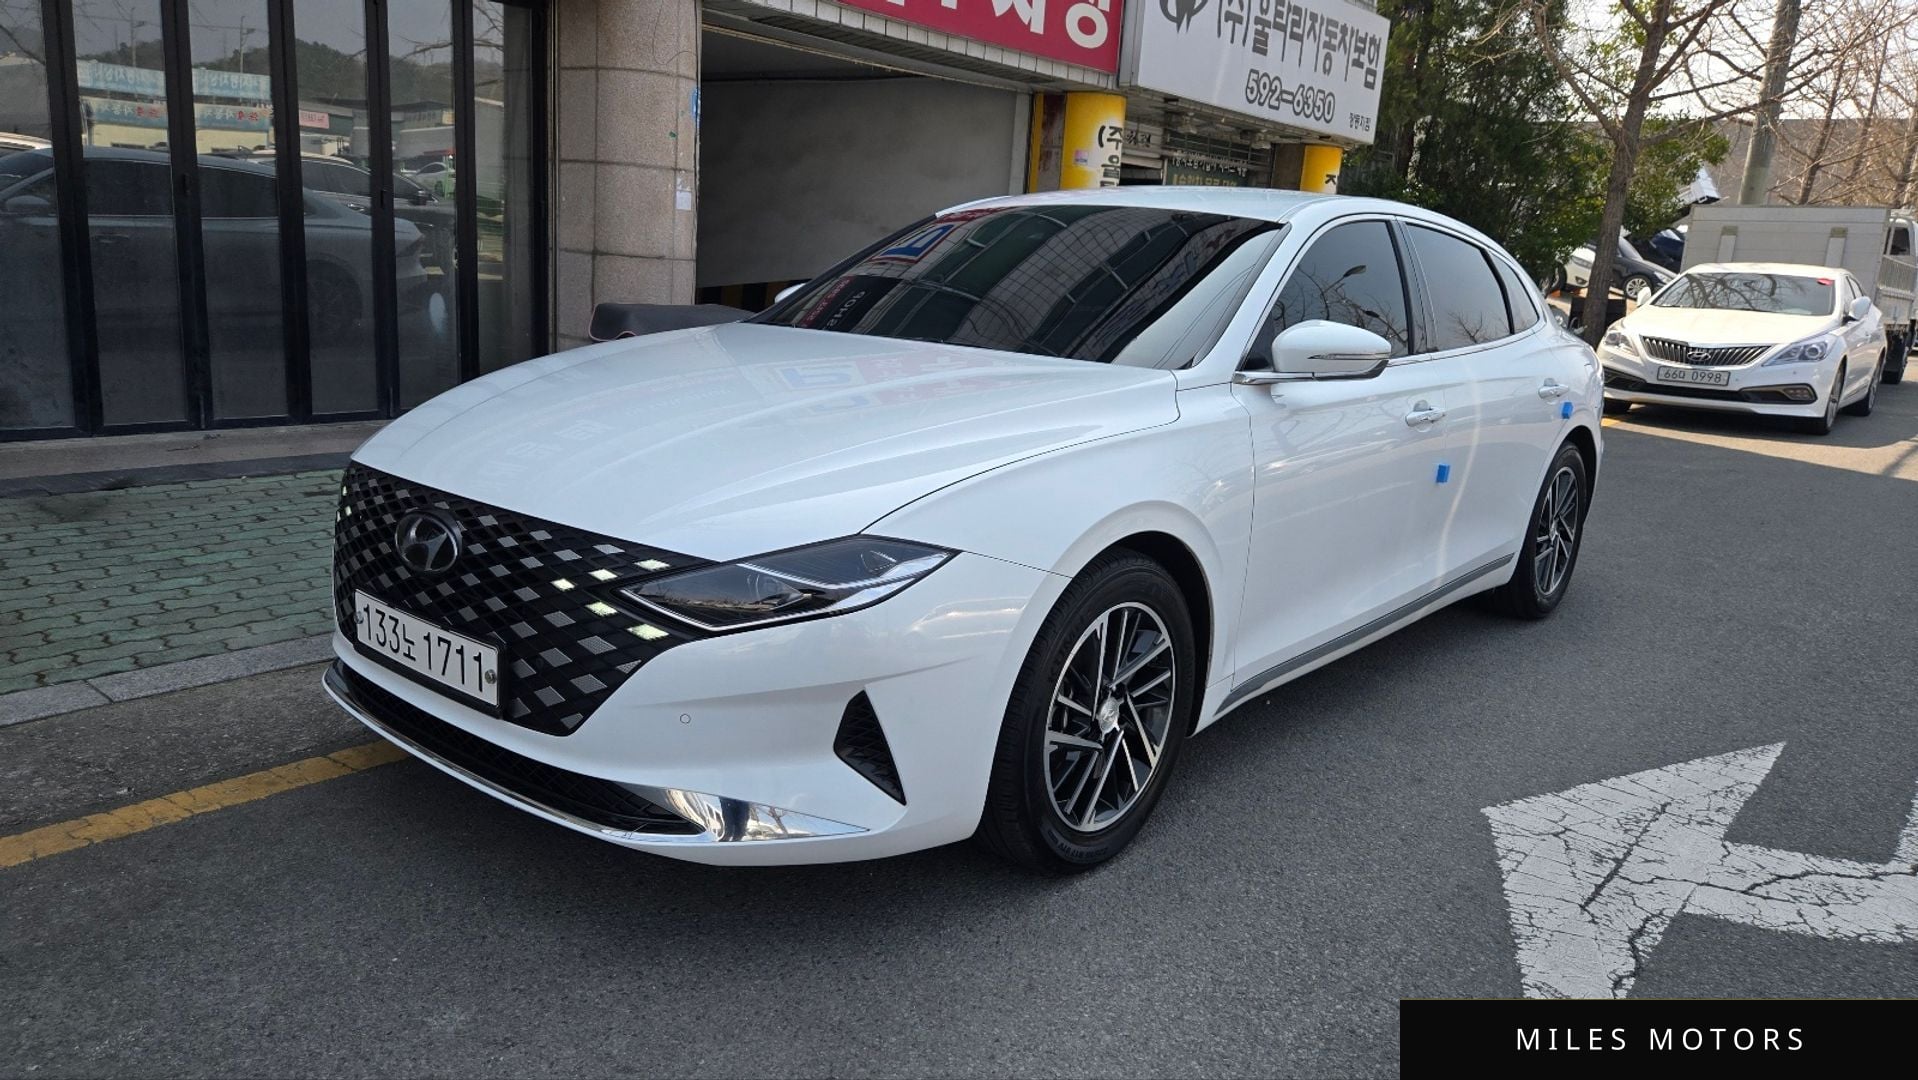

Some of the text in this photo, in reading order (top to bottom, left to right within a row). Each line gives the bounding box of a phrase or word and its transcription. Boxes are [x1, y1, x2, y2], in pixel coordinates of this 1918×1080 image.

[1245, 68, 1336, 124] 592-6350
[1691, 371, 1722, 383] 0998
[363, 603, 484, 693] 133노 1711
